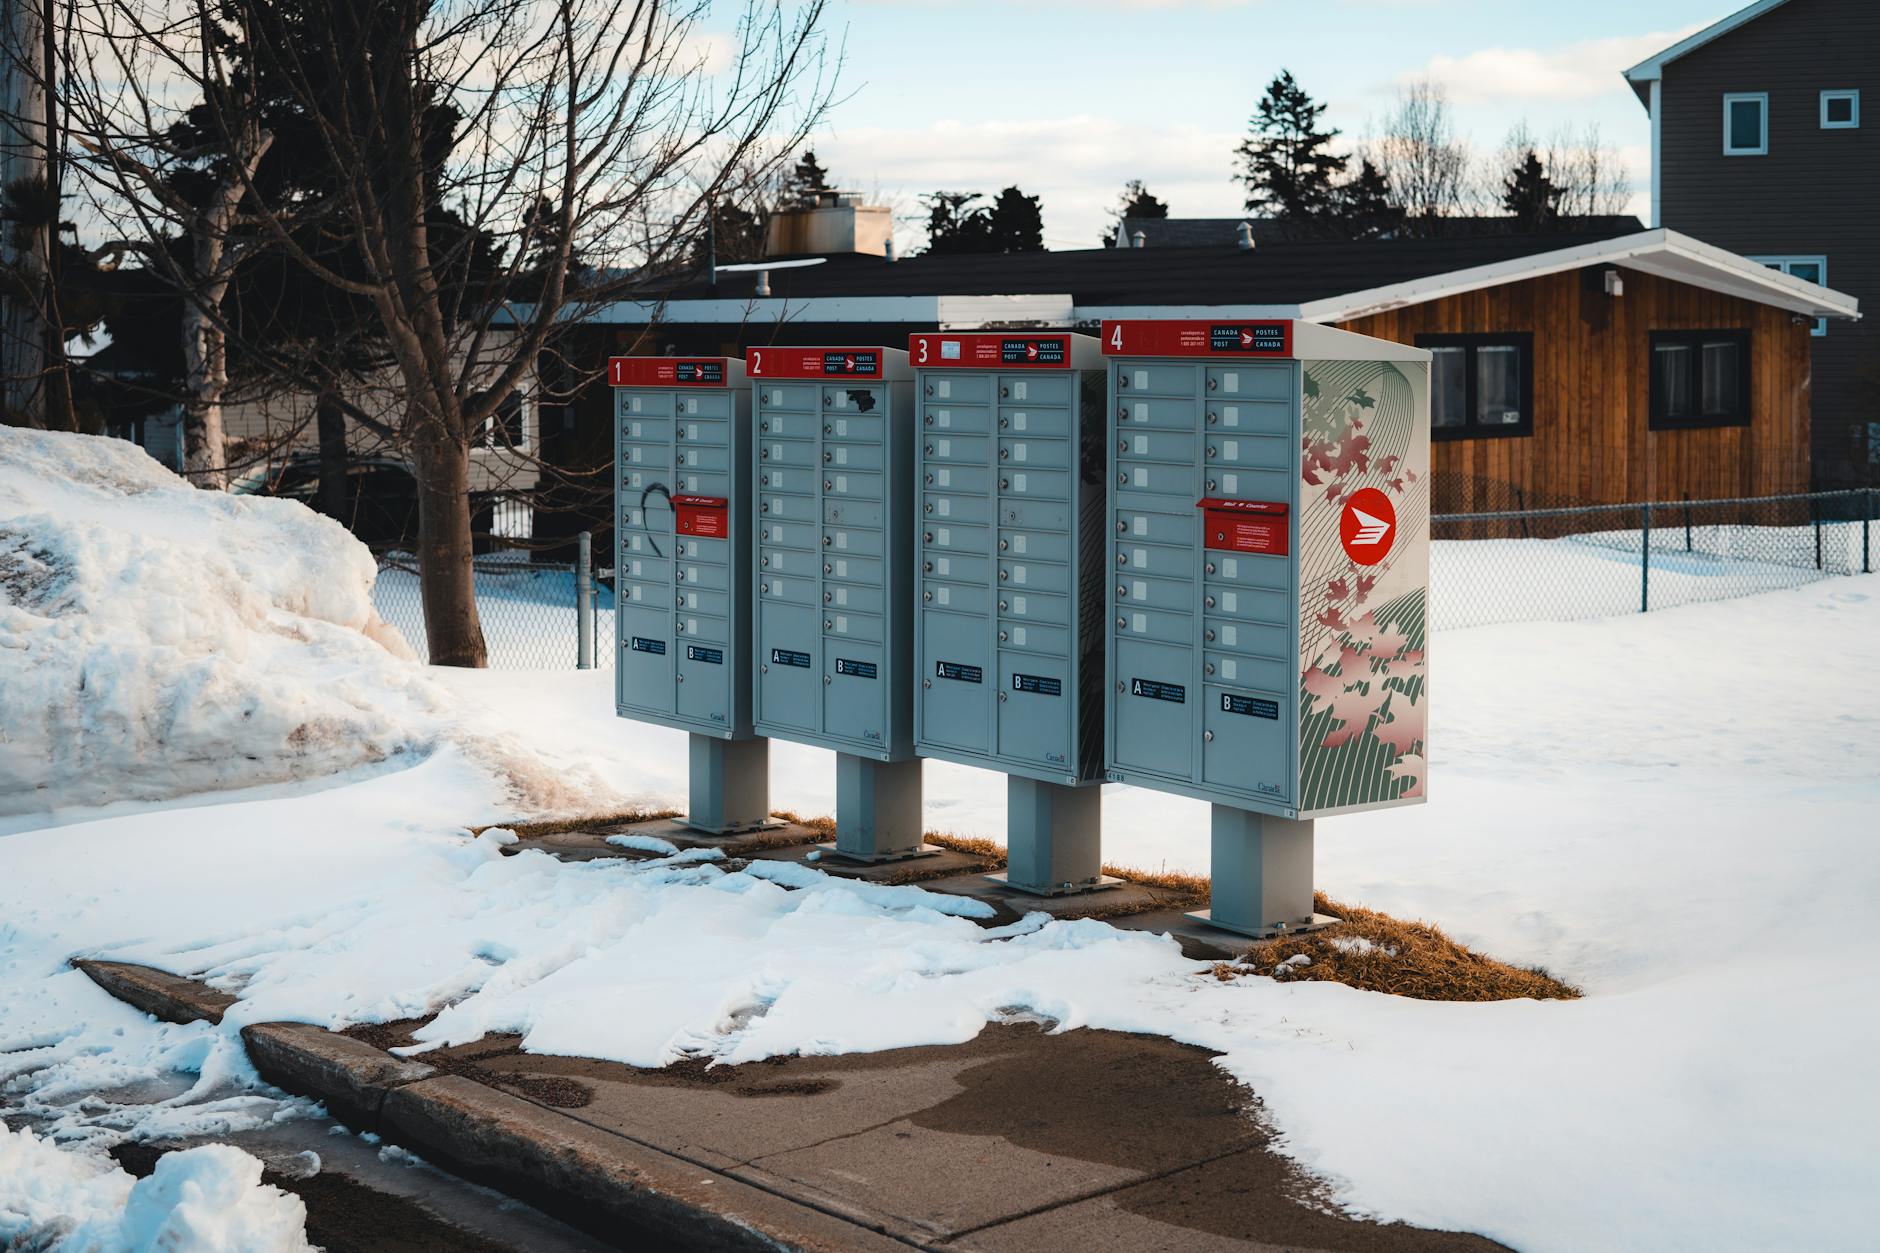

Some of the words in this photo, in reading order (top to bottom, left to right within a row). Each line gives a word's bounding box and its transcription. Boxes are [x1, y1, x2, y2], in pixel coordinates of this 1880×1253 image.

[1110, 324, 1122, 350] 4
[918, 338, 928, 363] 3
[753, 352, 762, 374] 2
[615, 362, 621, 382] 1
[633, 638, 639, 649] A
[689, 647, 694, 659] B
[773, 650, 780, 662] A
[838, 660, 843, 672] B
[938, 663, 945, 676] A
[1015, 675, 1021, 689] B
[1133, 680, 1142, 695] A
[1224, 695, 1231, 710] B
